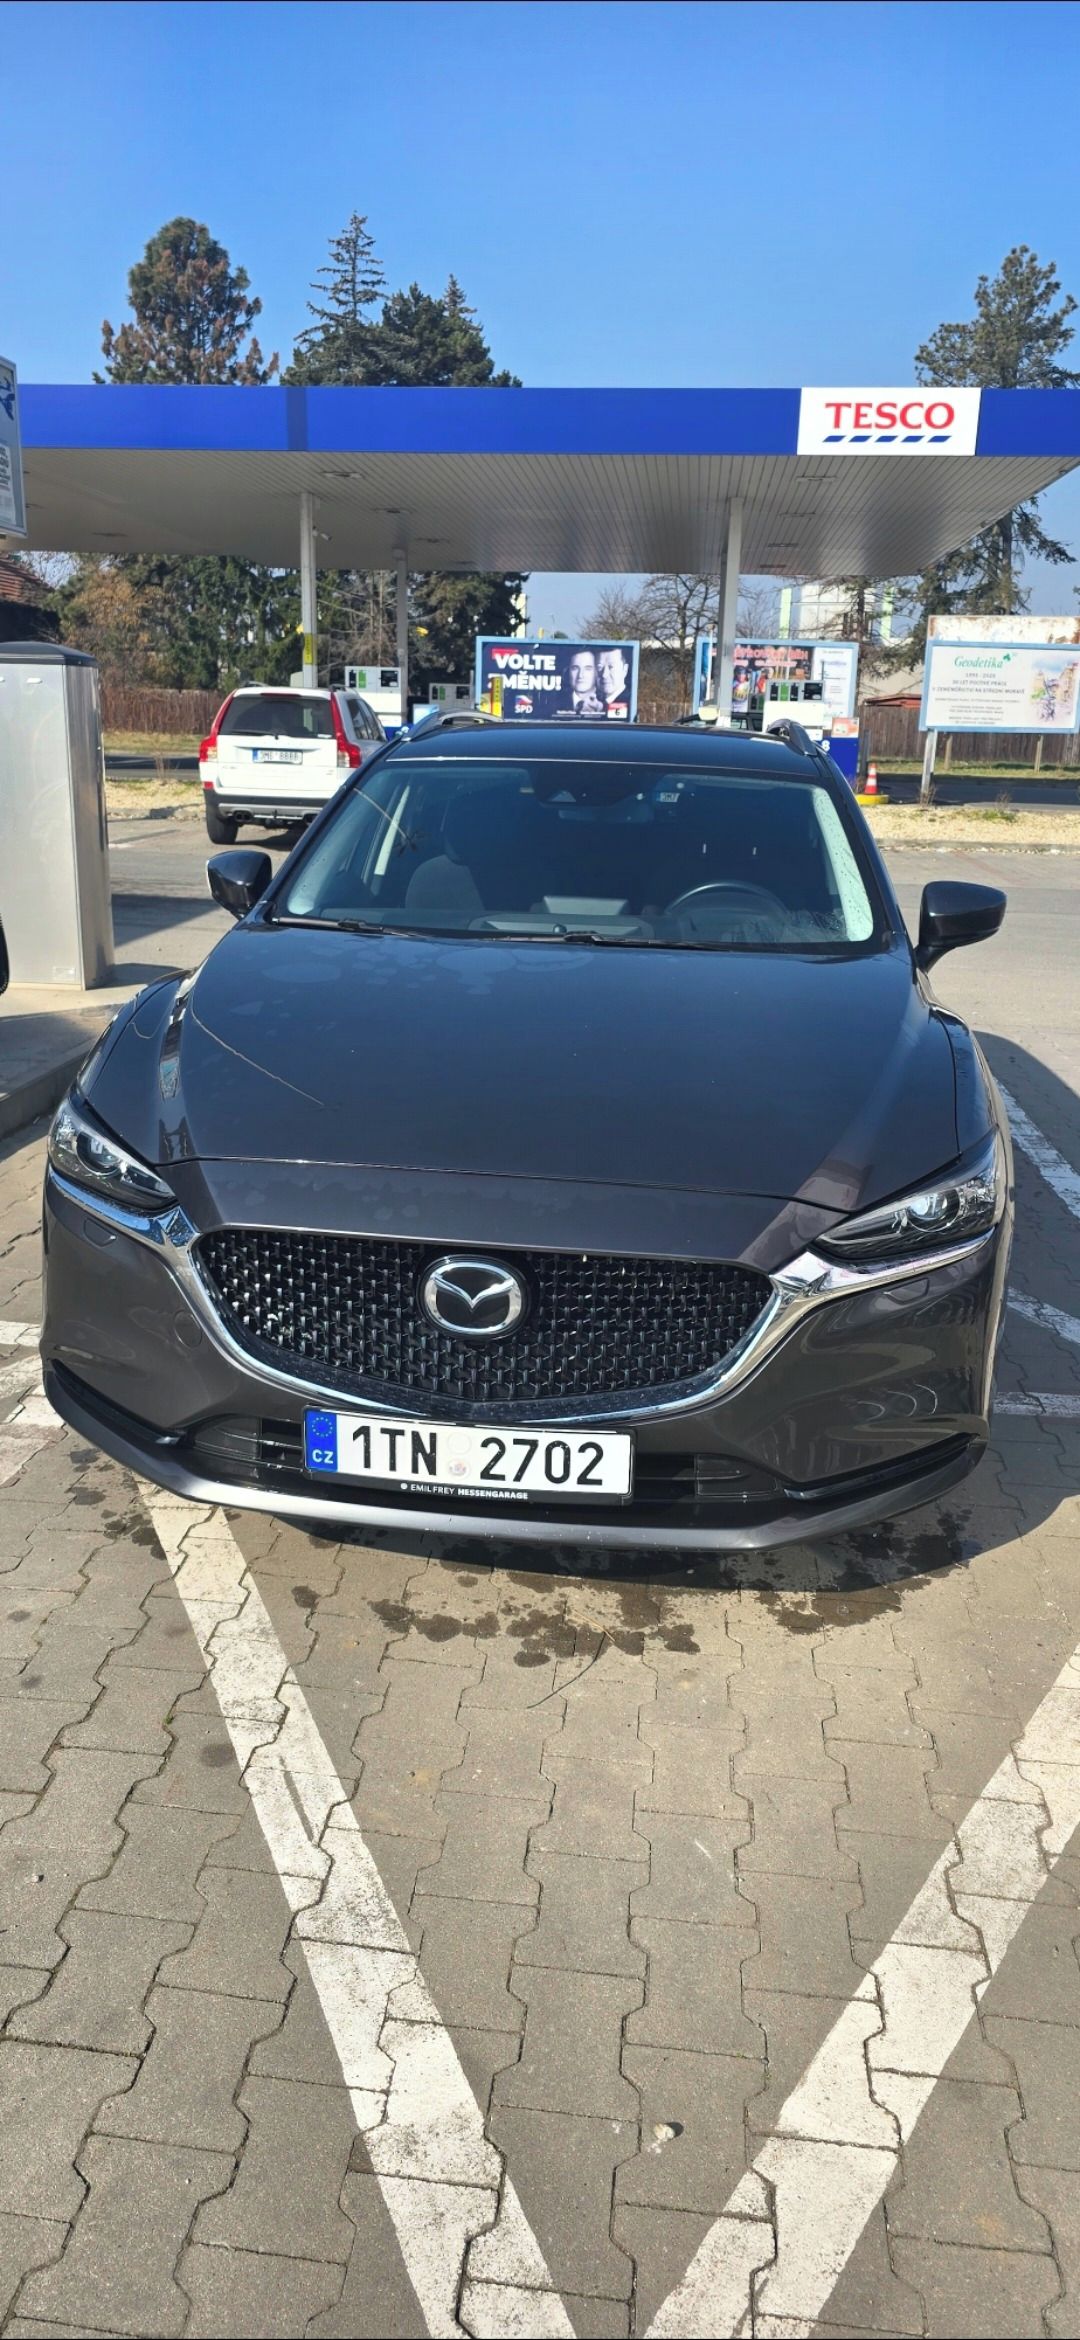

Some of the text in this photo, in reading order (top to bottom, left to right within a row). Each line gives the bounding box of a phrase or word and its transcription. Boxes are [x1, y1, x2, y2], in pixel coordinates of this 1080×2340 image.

[825, 402, 955, 429] TESCO
[495, 655, 556, 670] VOLTE
[954, 655, 1003, 669] Geodetika
[515, 705, 533, 714] SPD
[821, 740, 831, 752] 8
[312, 1449, 334, 1465] CZ
[352, 1425, 604, 1486] 1TN 2702
[410, 1484, 529, 1500] EMIL FREY HESSENGARAGE
